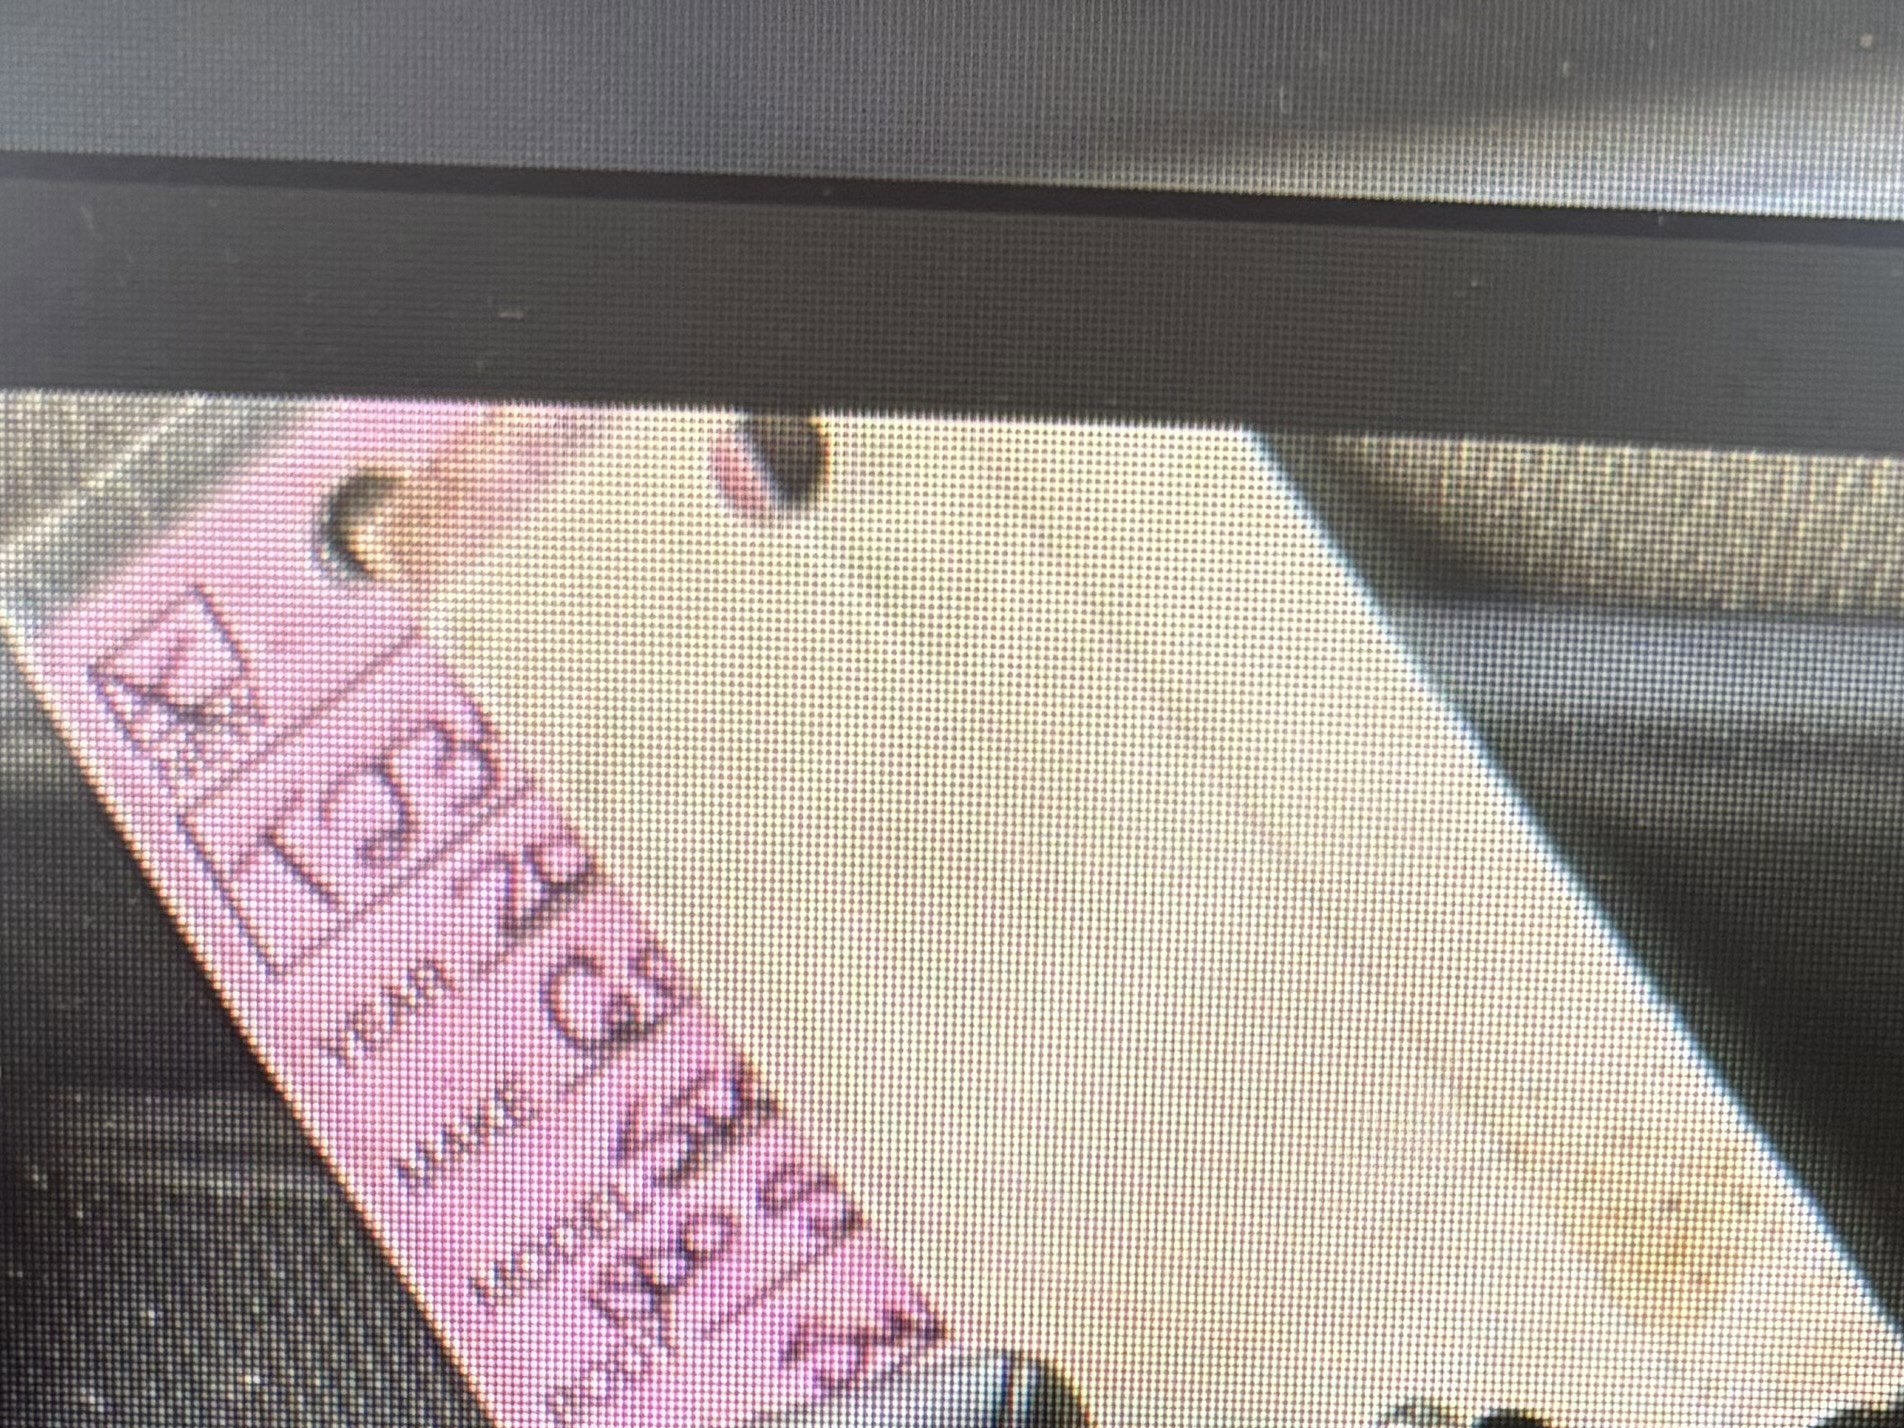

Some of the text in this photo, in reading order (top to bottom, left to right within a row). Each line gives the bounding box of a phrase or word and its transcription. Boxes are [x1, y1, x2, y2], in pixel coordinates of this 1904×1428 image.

[230, 700, 503, 906] T23
[312, 952, 457, 1075] YEAR
[391, 1072, 543, 1200] MAKE
[466, 1176, 654, 1317] MODEL
